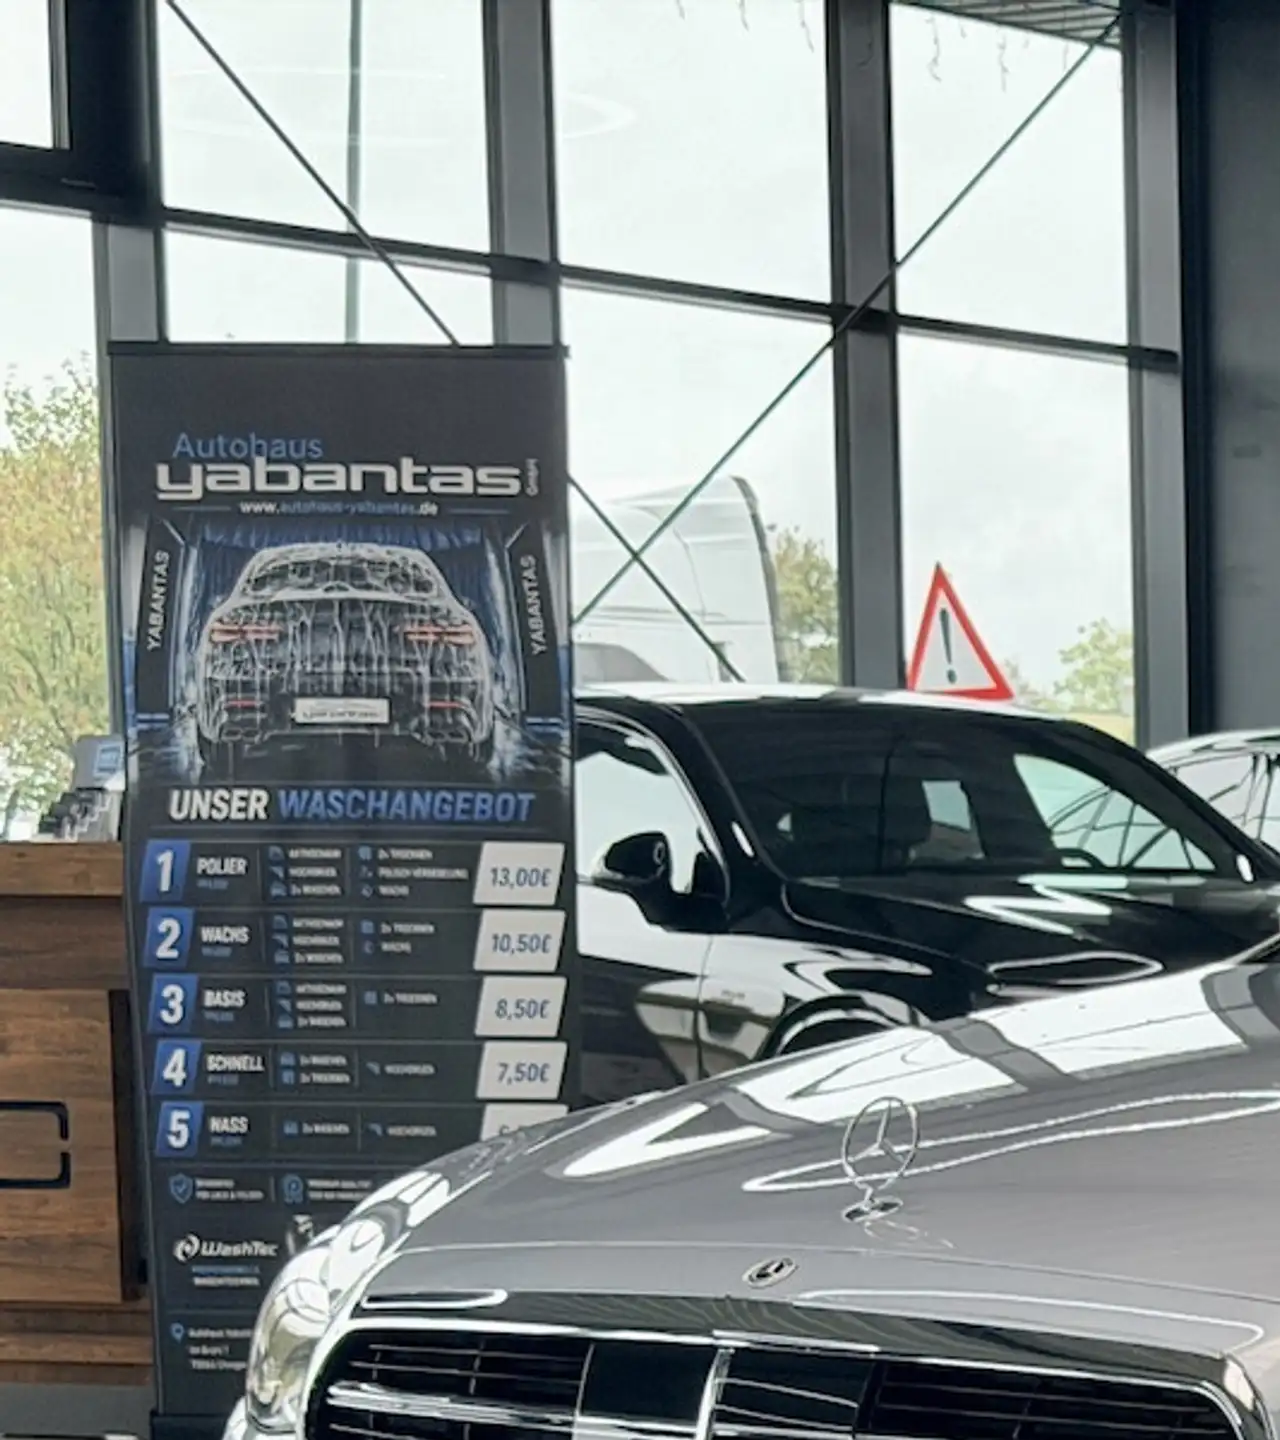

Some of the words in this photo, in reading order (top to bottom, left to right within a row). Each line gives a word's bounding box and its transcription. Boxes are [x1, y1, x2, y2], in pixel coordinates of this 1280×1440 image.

[172, 433, 323, 459] Autohaus
[156, 457, 521, 499] yabantas
[147, 550, 170, 652] YABANTAS
[520, 554, 546, 656] YABANTAS
[169, 789, 268, 821] UNSER
[278, 790, 536, 823] WASCHANGEBOT
[155, 851, 174, 892] 1
[197, 857, 248, 877] POLIER
[489, 866, 552, 889] 13,00€
[155, 920, 182, 959] 2
[201, 926, 249, 945] WACHS
[491, 933, 552, 955] 10,50€
[160, 985, 184, 1024] 3
[204, 990, 246, 1008] BASIS
[494, 999, 551, 1021] 8,50€
[163, 1049, 187, 1087] 4
[206, 1055, 265, 1073] SCHNELL
[497, 1062, 551, 1085] 7,50€
[167, 1111, 192, 1149] 5
[210, 1117, 249, 1135] NASS
[200, 1240, 278, 1258] WashTec
